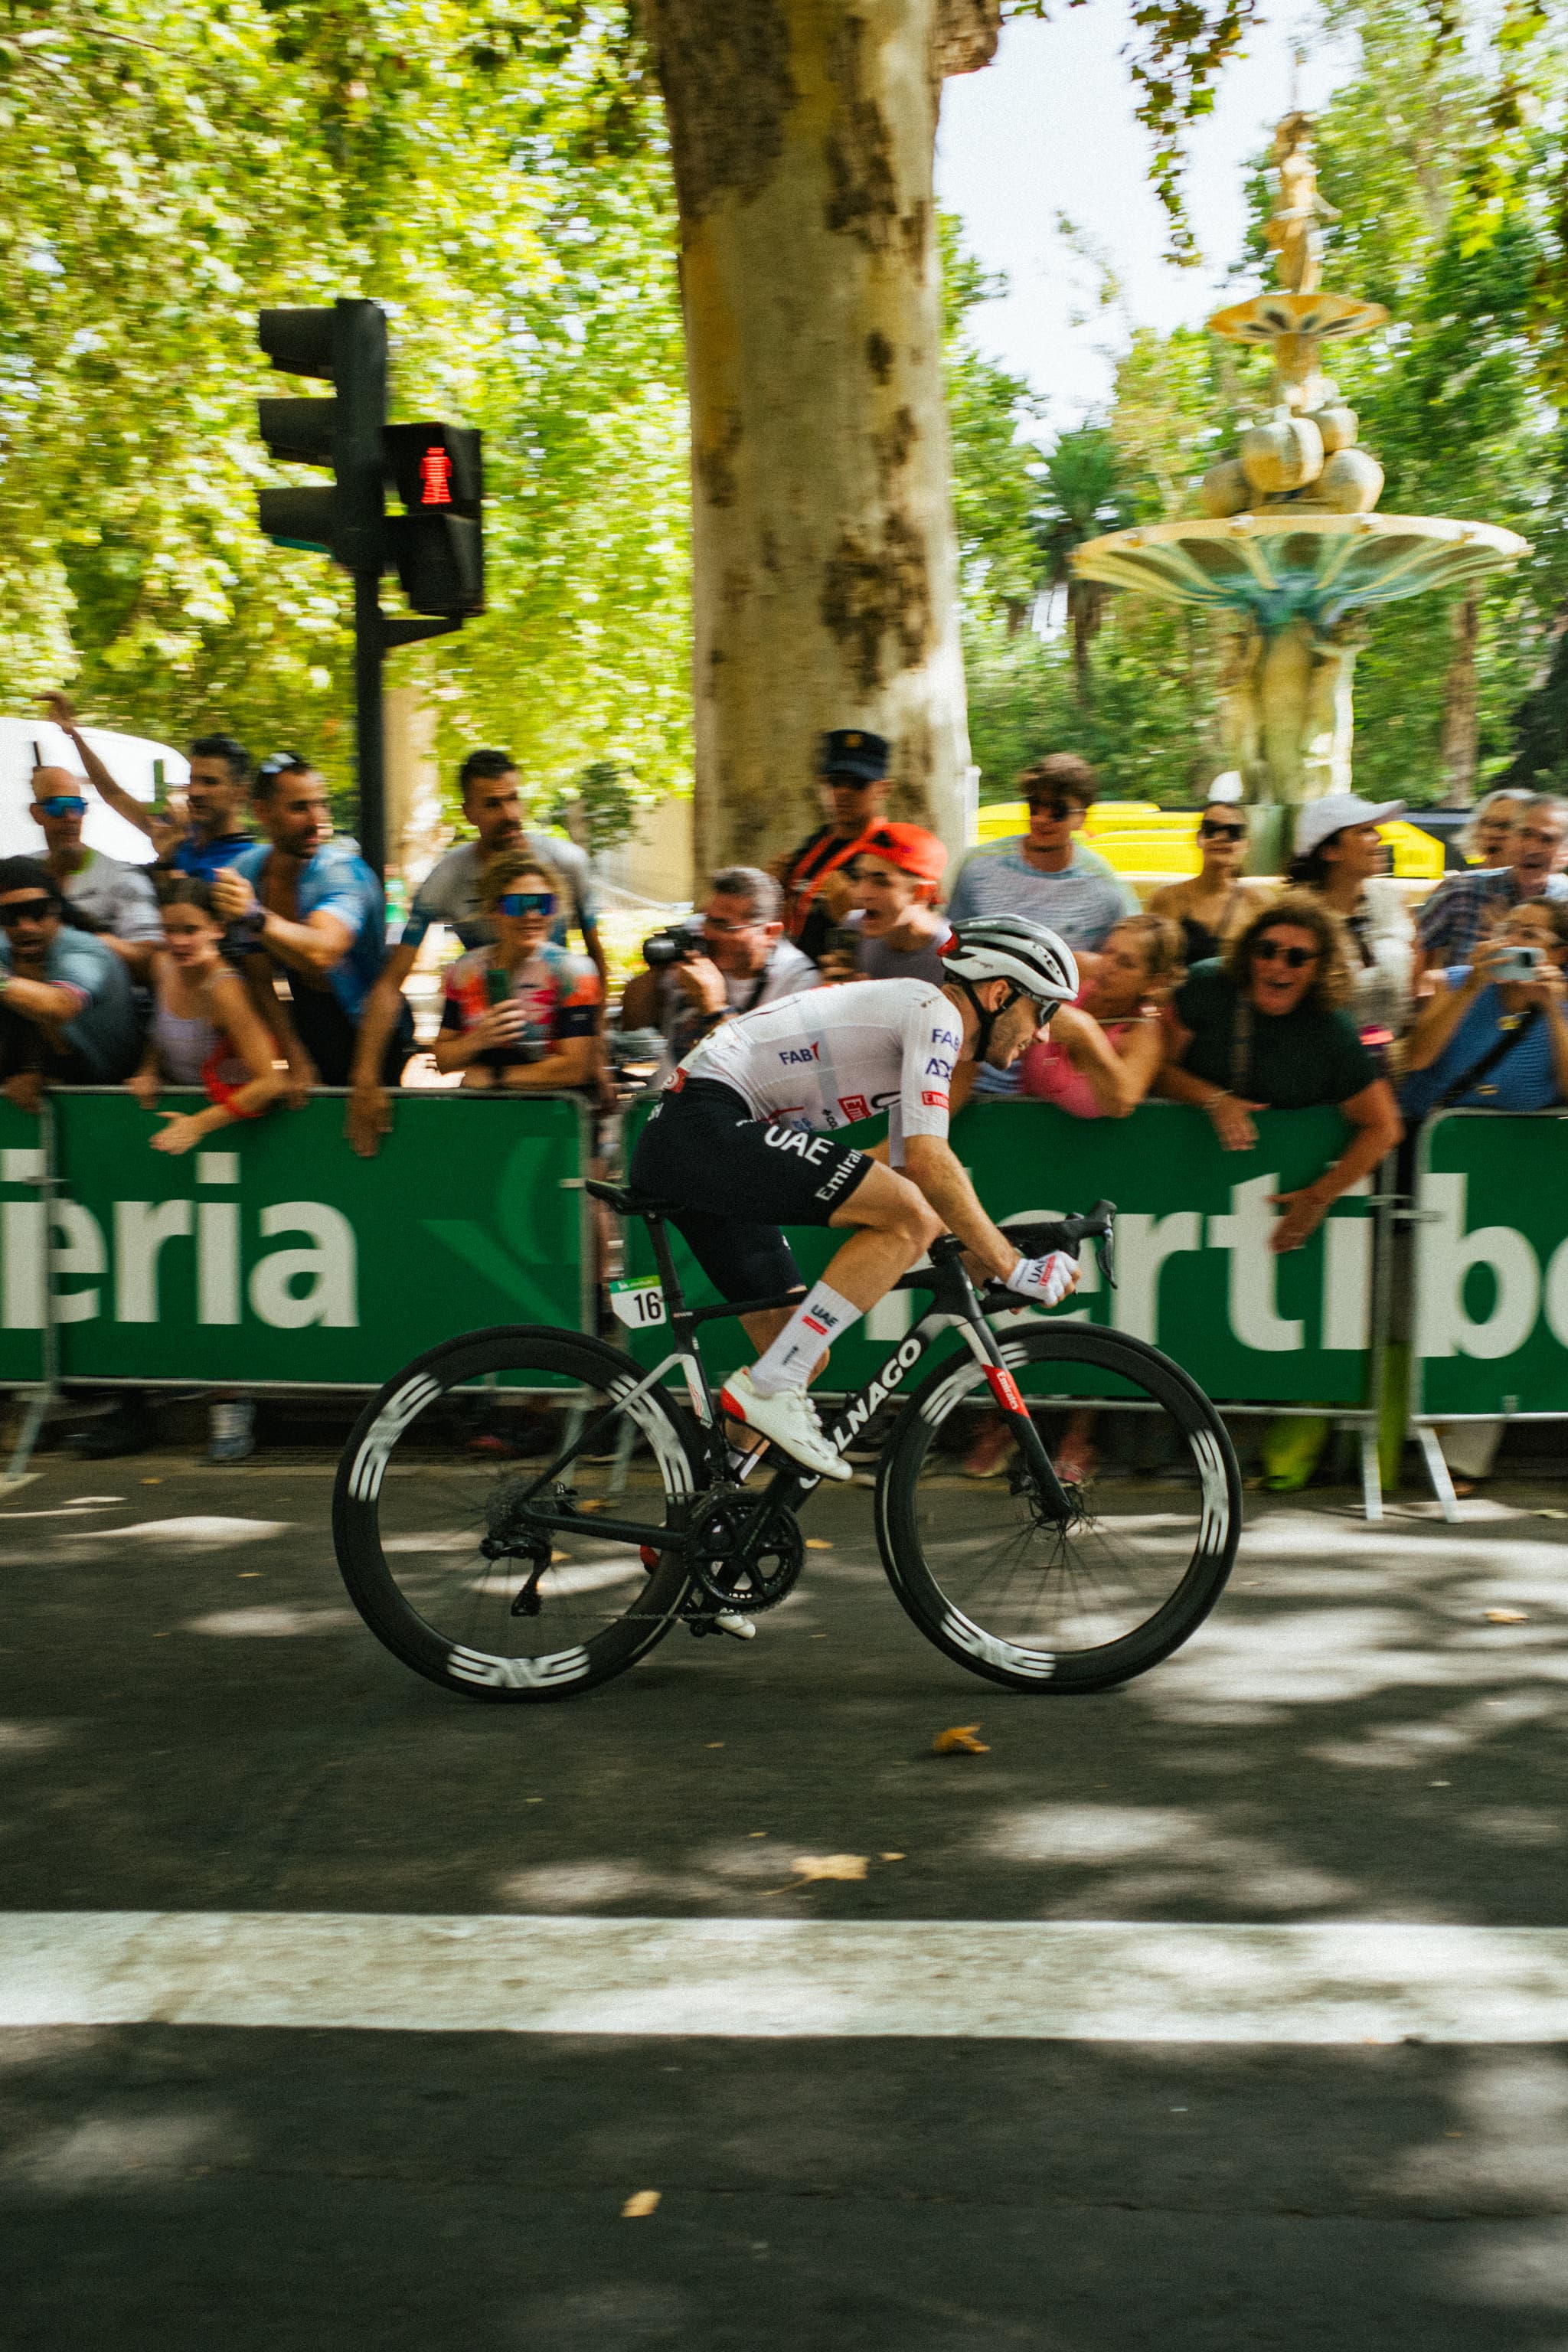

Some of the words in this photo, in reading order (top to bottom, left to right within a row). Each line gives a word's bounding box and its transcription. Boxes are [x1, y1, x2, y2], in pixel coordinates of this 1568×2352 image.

[764, 1125, 835, 1166] UAE
[634, 1292, 662, 1321] 16
[811, 1304, 838, 1328] UAE
